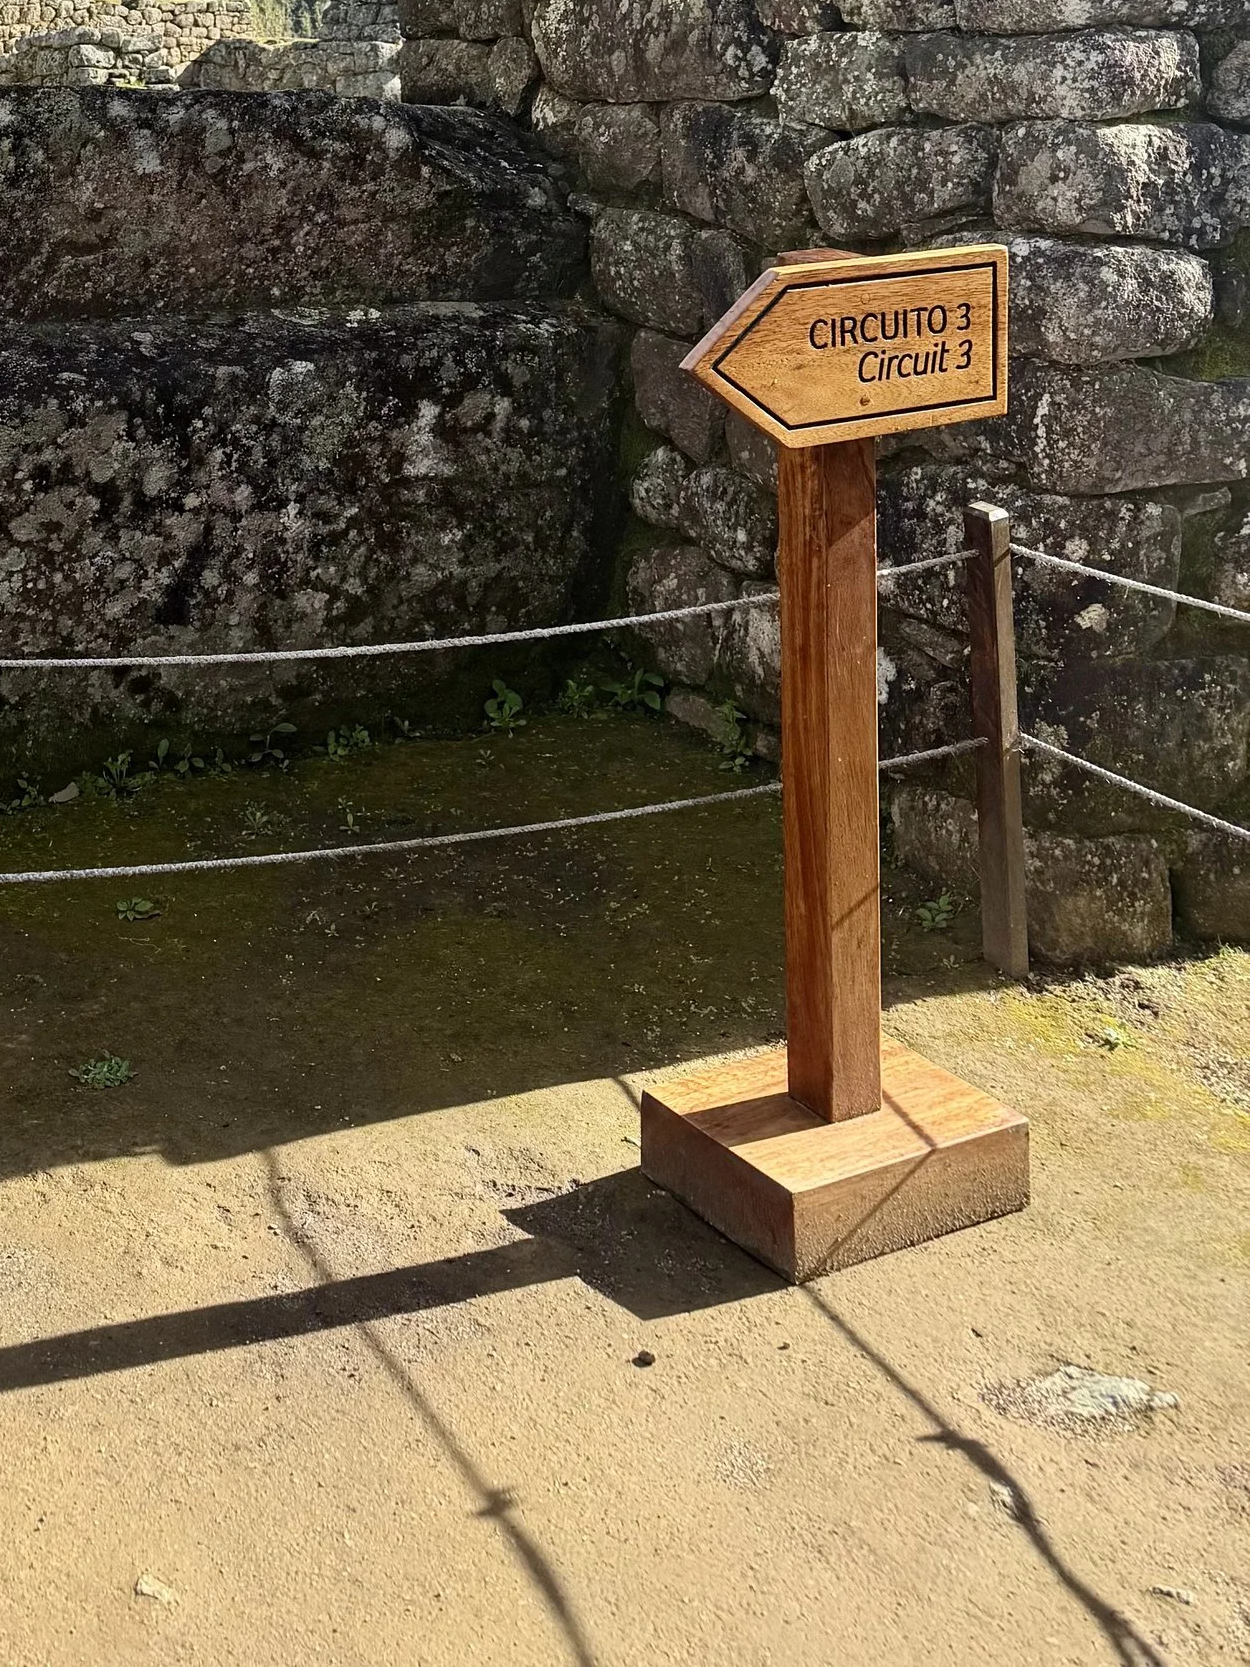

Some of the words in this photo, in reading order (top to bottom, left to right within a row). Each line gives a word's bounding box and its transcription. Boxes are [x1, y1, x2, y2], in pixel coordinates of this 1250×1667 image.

[809, 304, 948, 350] CIRCUITO
[956, 302, 971, 331] 3
[858, 342, 949, 383] Circuit
[955, 339, 973, 369] 3
